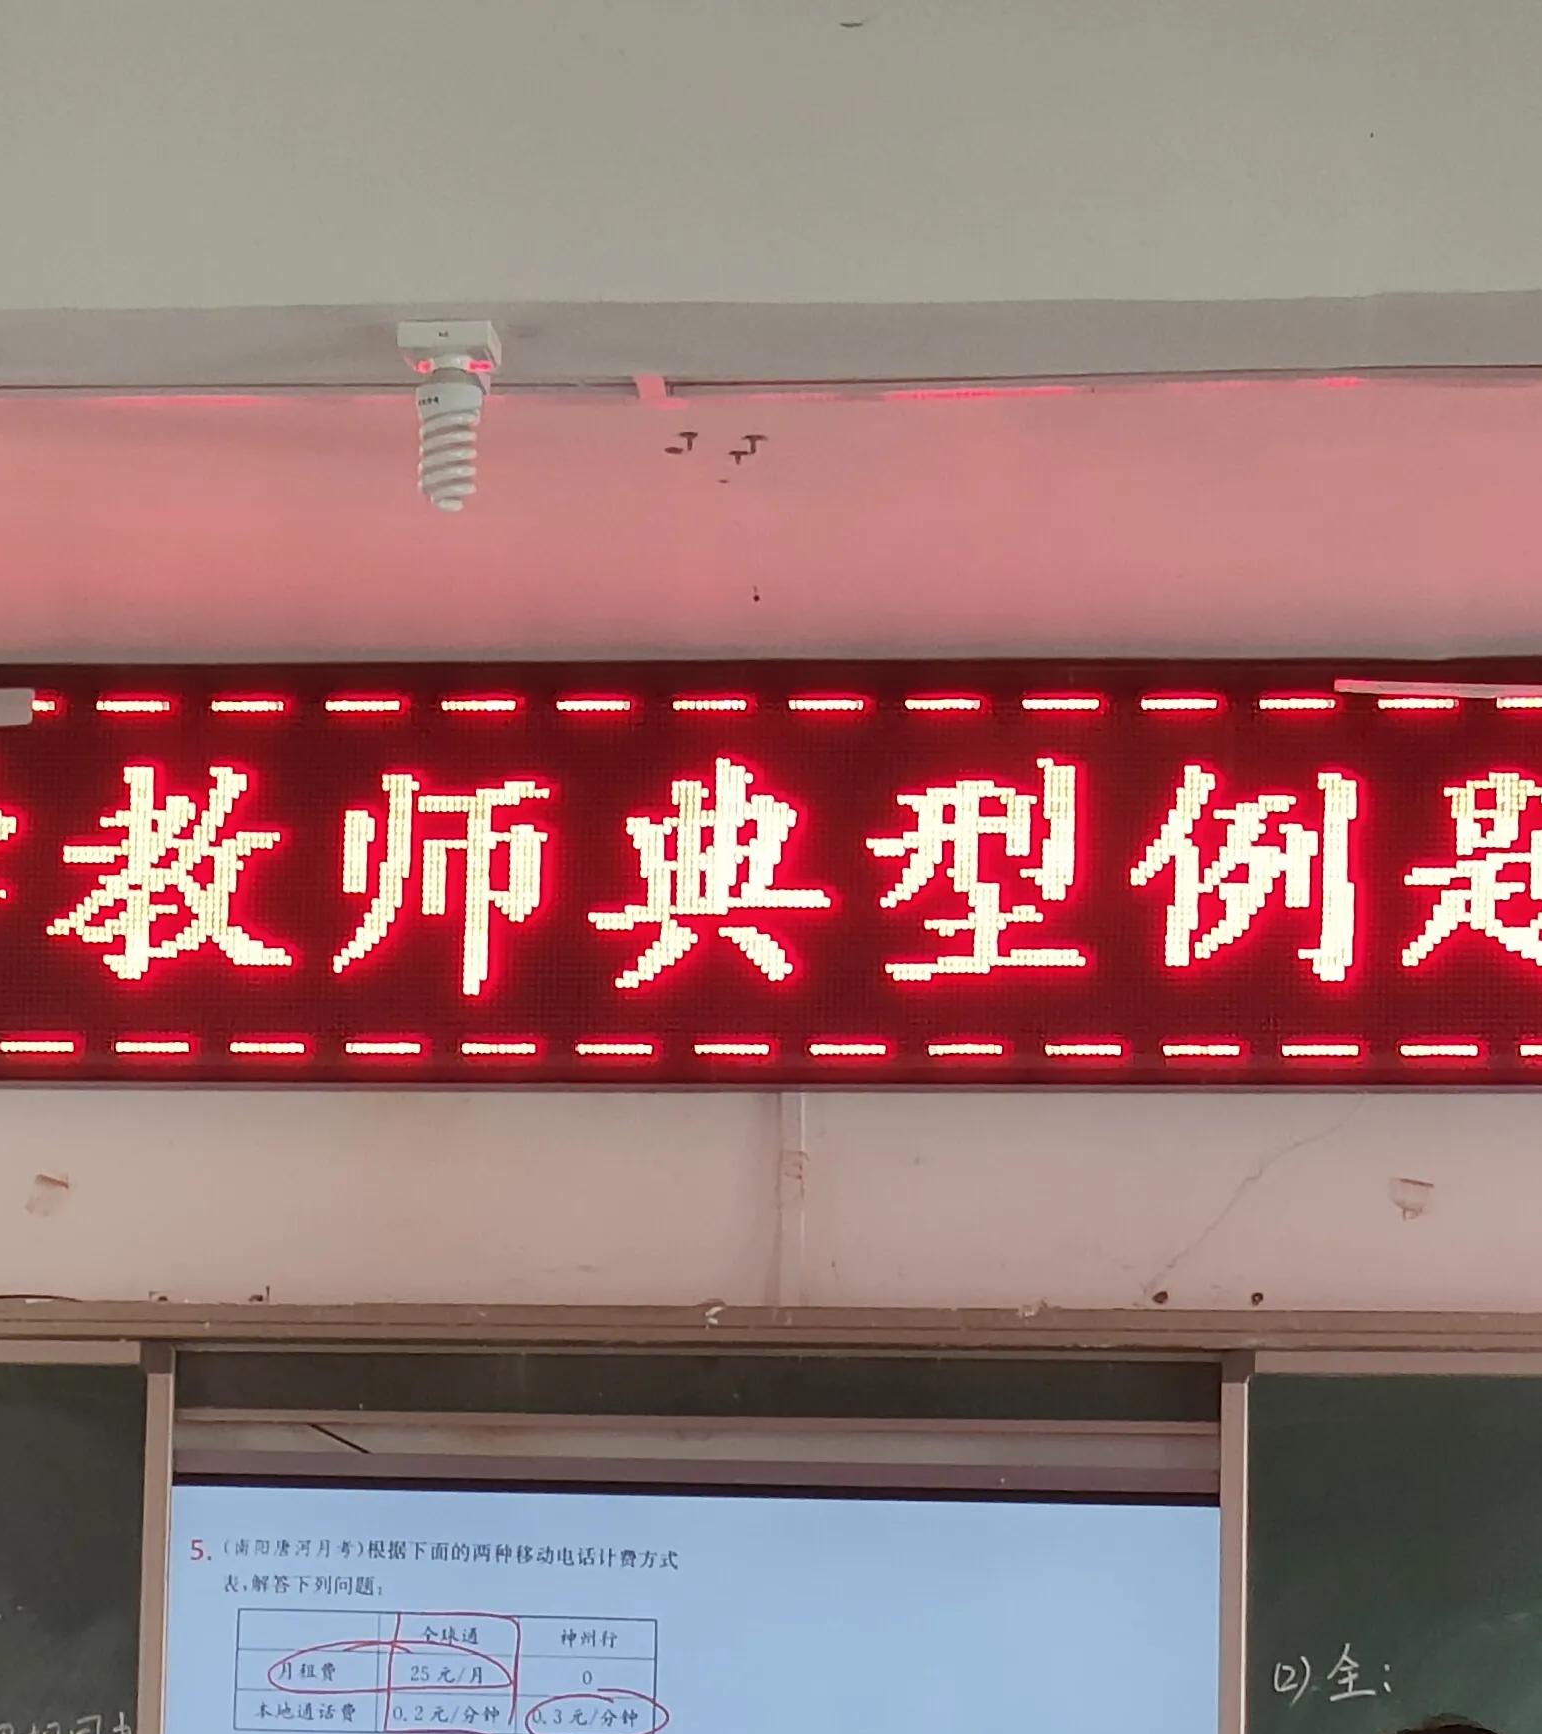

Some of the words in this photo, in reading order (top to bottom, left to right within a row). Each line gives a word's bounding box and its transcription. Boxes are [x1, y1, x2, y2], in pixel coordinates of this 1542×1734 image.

[421, 1625, 480, 1647] 全球通
[560, 1629, 619, 1650] 神州行
[278, 1661, 337, 1681] 月租费
[582, 1670, 593, 1685] 0
[254, 1701, 357, 1722] 本地通话费
